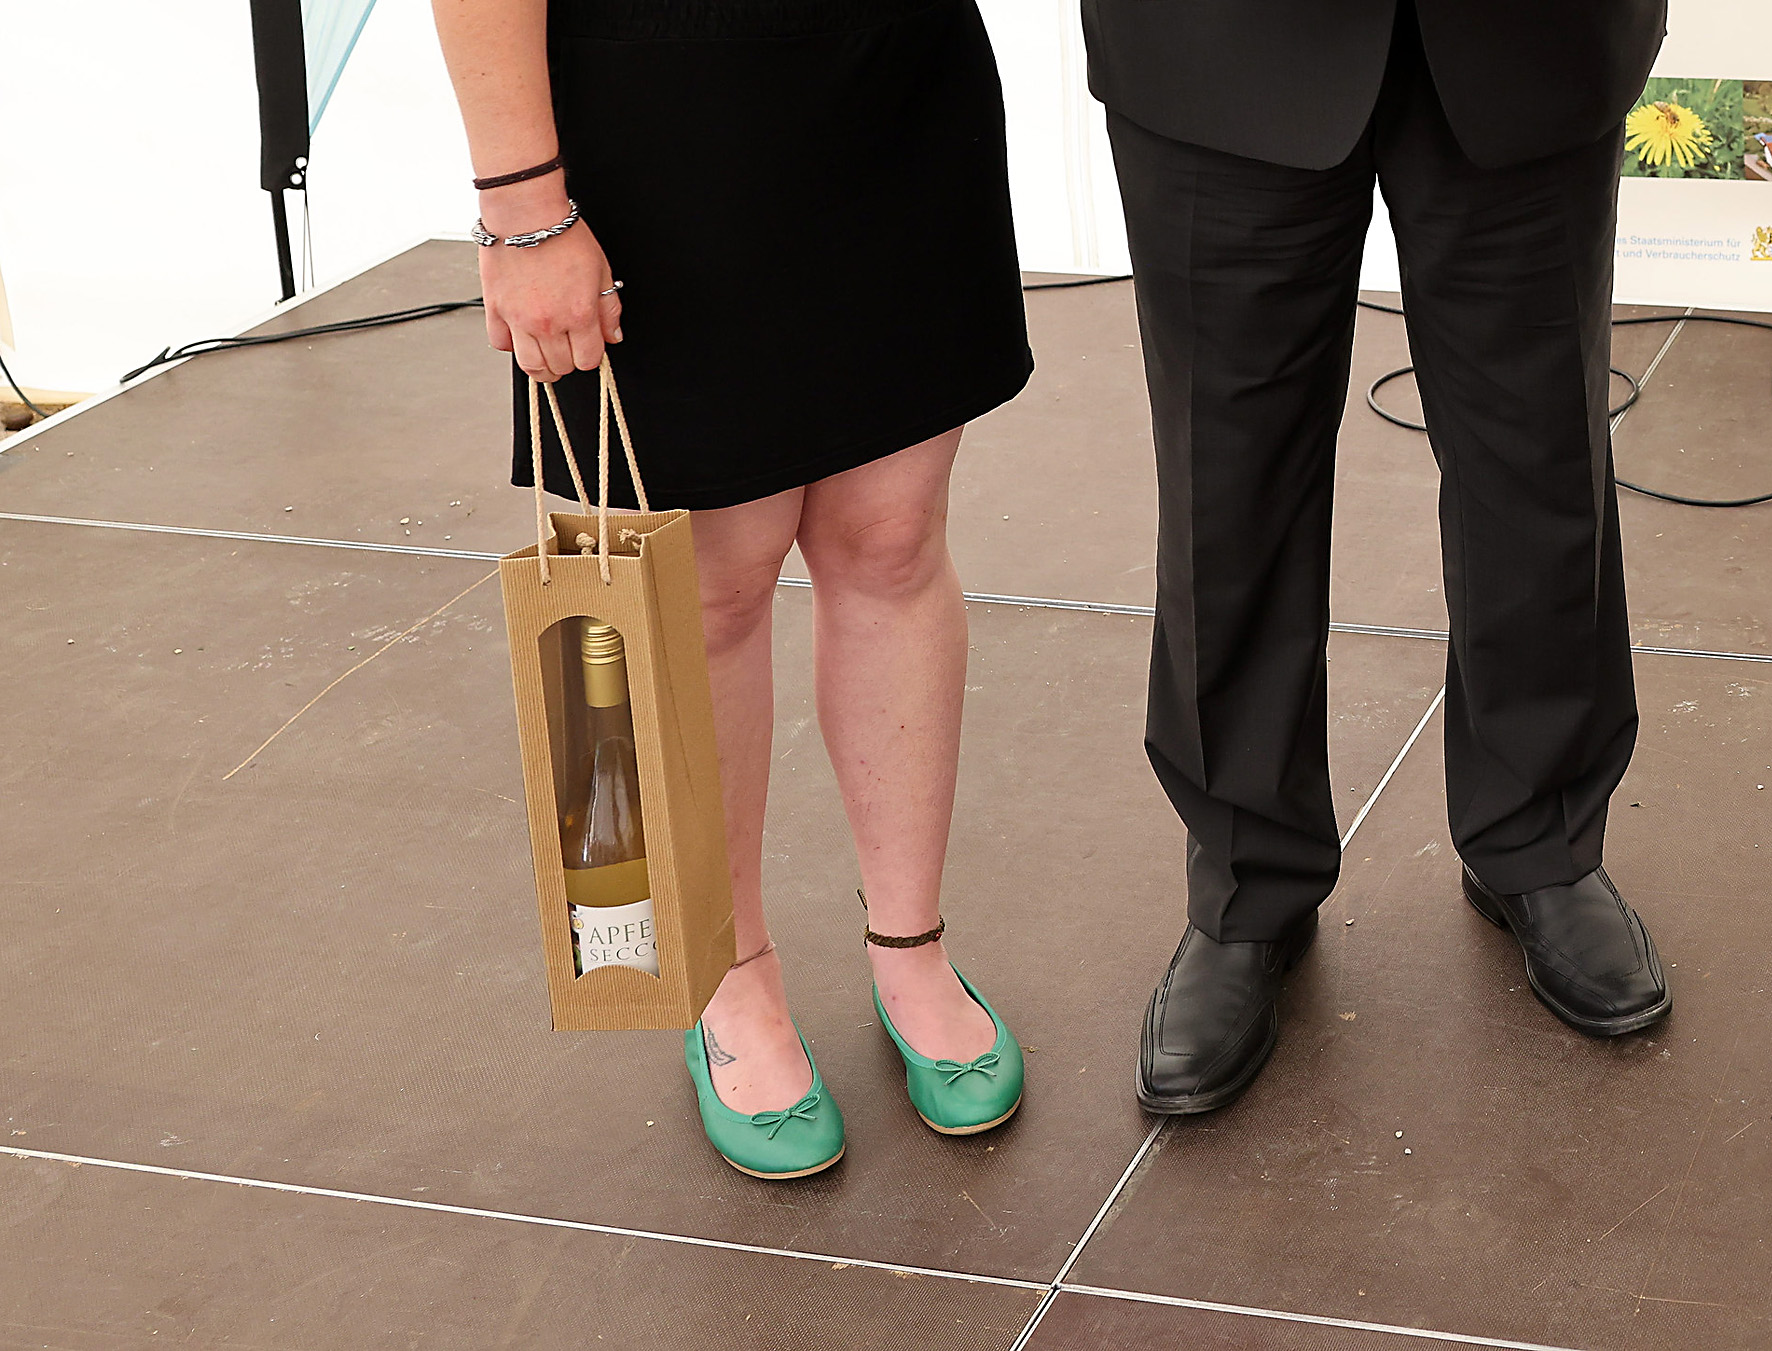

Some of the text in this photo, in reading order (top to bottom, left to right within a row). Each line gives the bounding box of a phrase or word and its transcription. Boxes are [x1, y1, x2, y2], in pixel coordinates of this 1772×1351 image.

[1630, 235, 1723, 248] Staatsministerium
[1726, 238, 1741, 248] für
[1623, 249, 1642, 258] und
[1645, 249, 1741, 262] Verbraucherschutz
[589, 918, 652, 945] APFE
[590, 941, 657, 962] SECC
